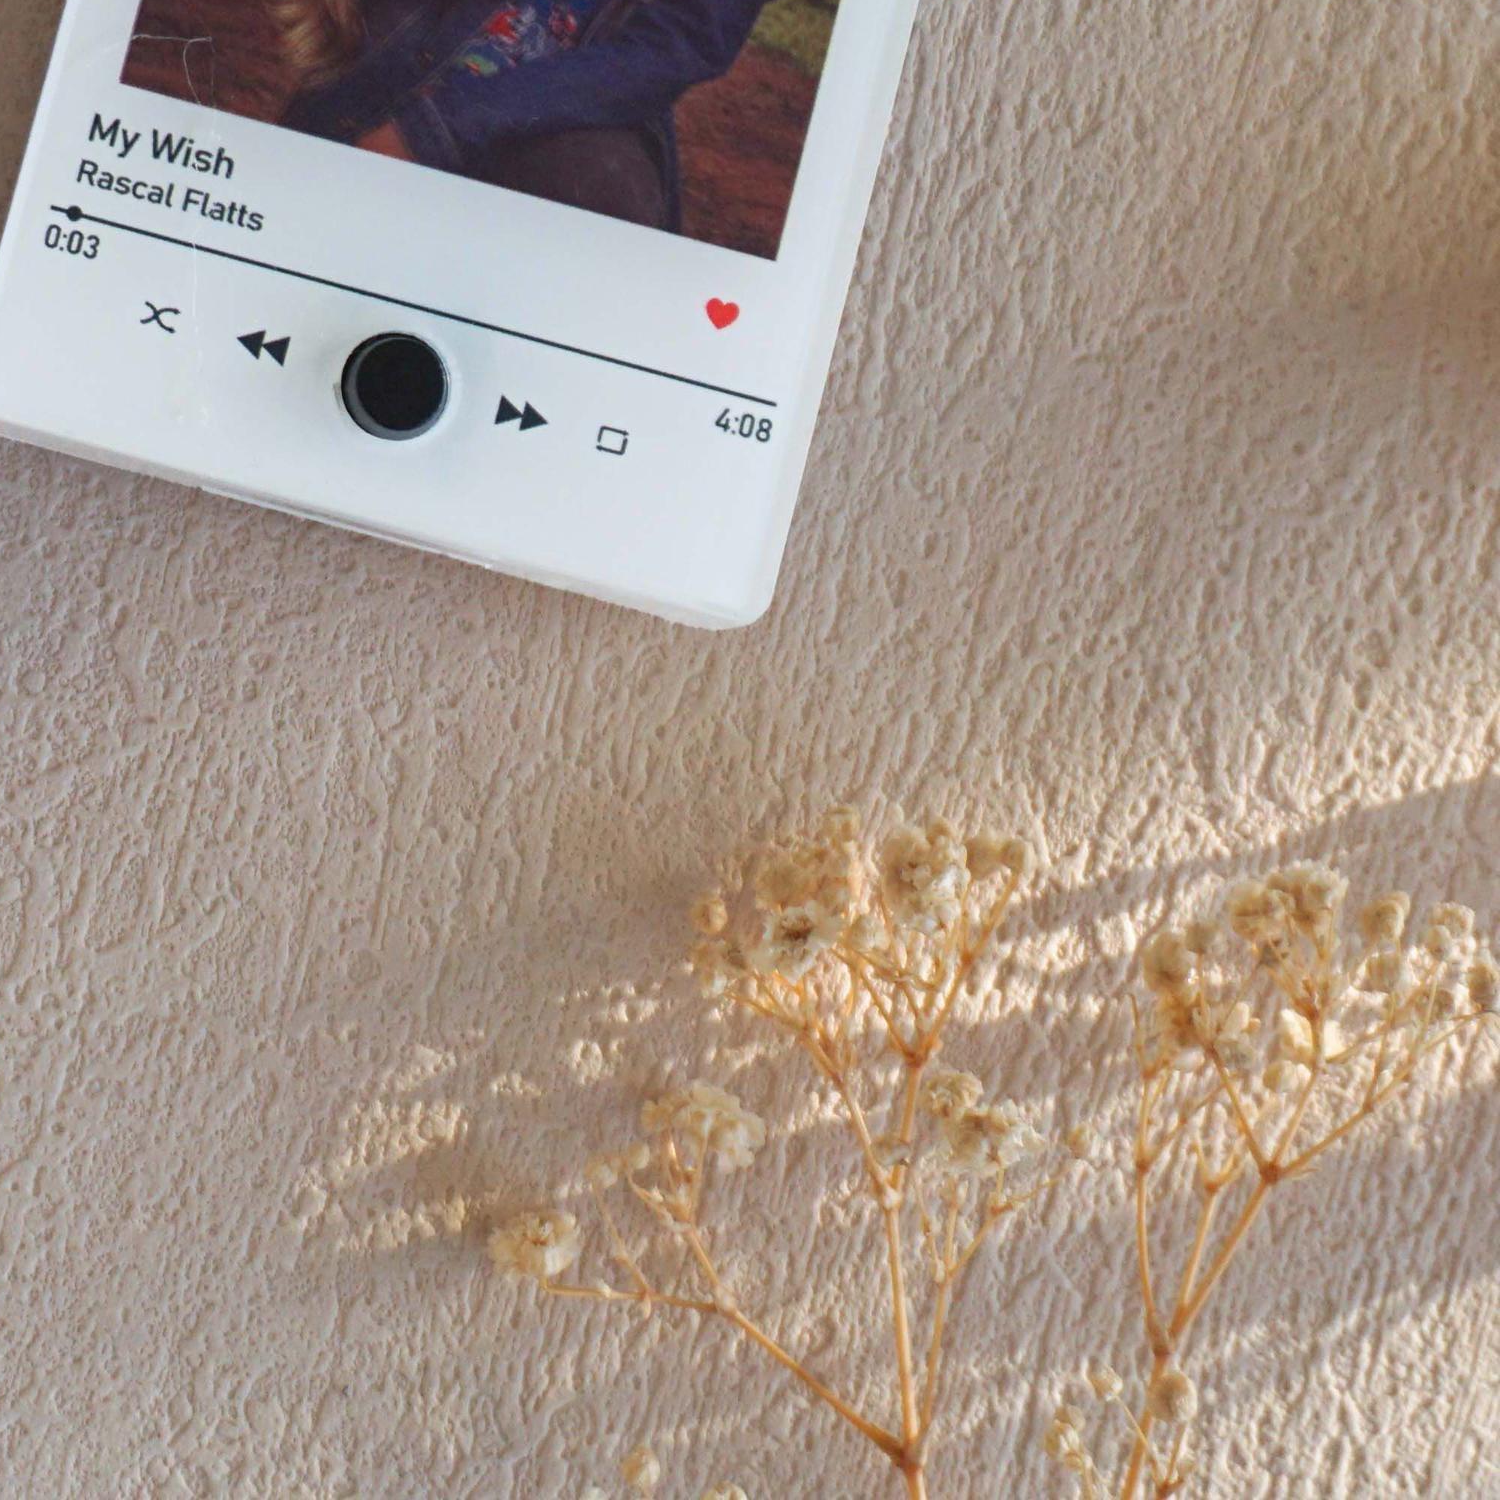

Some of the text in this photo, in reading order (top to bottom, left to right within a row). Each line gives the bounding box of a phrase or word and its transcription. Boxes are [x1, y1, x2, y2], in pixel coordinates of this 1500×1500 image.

[88, 113, 235, 179] My Wish
[76, 159, 265, 231] Rascal Flatts
[44, 224, 101, 260] 0:03
[715, 408, 773, 443] 4:08
